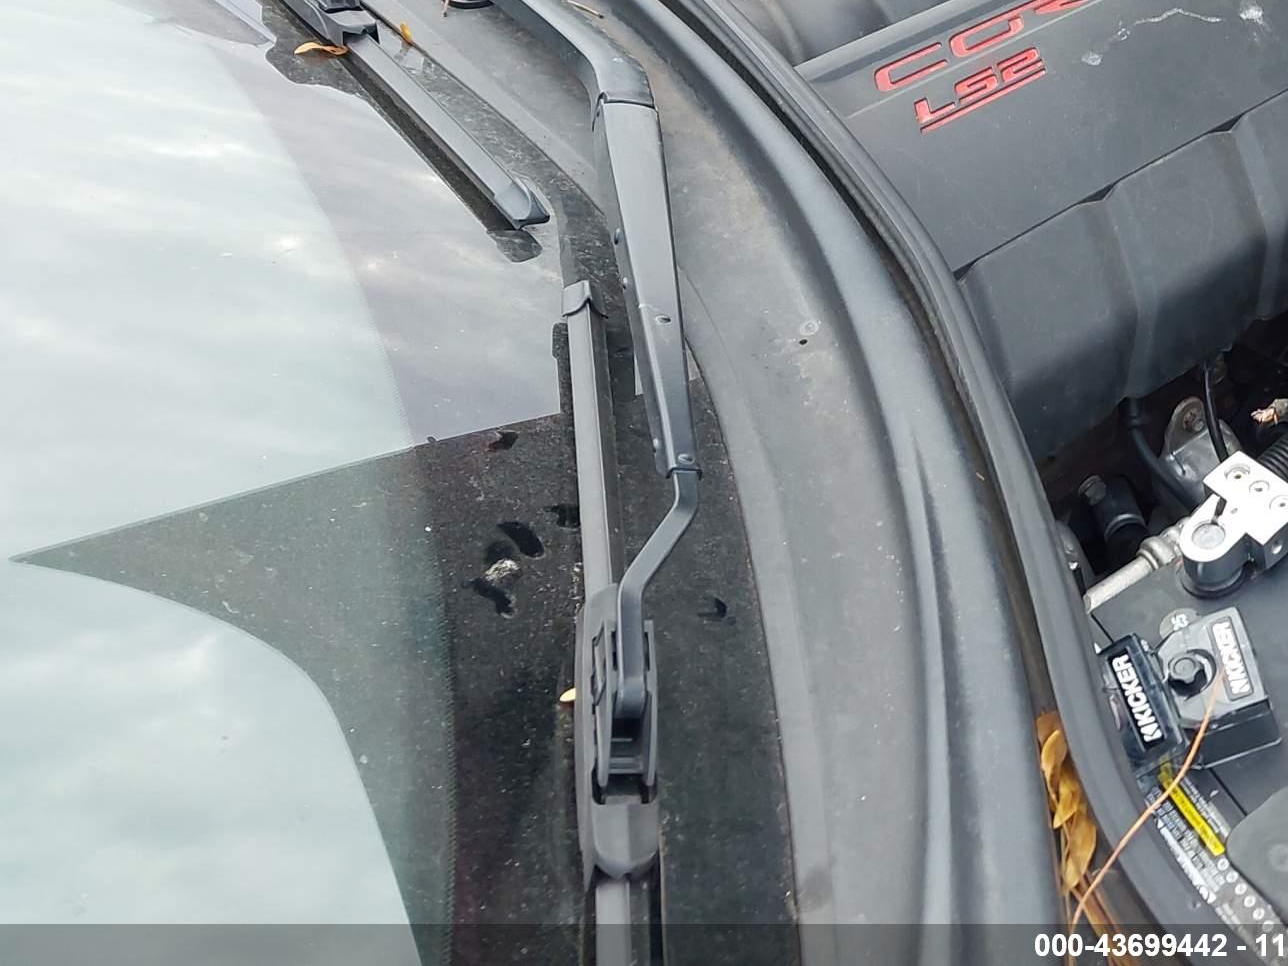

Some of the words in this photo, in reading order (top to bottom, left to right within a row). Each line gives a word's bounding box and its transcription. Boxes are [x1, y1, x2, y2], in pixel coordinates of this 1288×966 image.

[913, 47, 1047, 127] LS2
[1212, 622, 1252, 694] KICKER
[1112, 654, 1163, 743] KICKER
